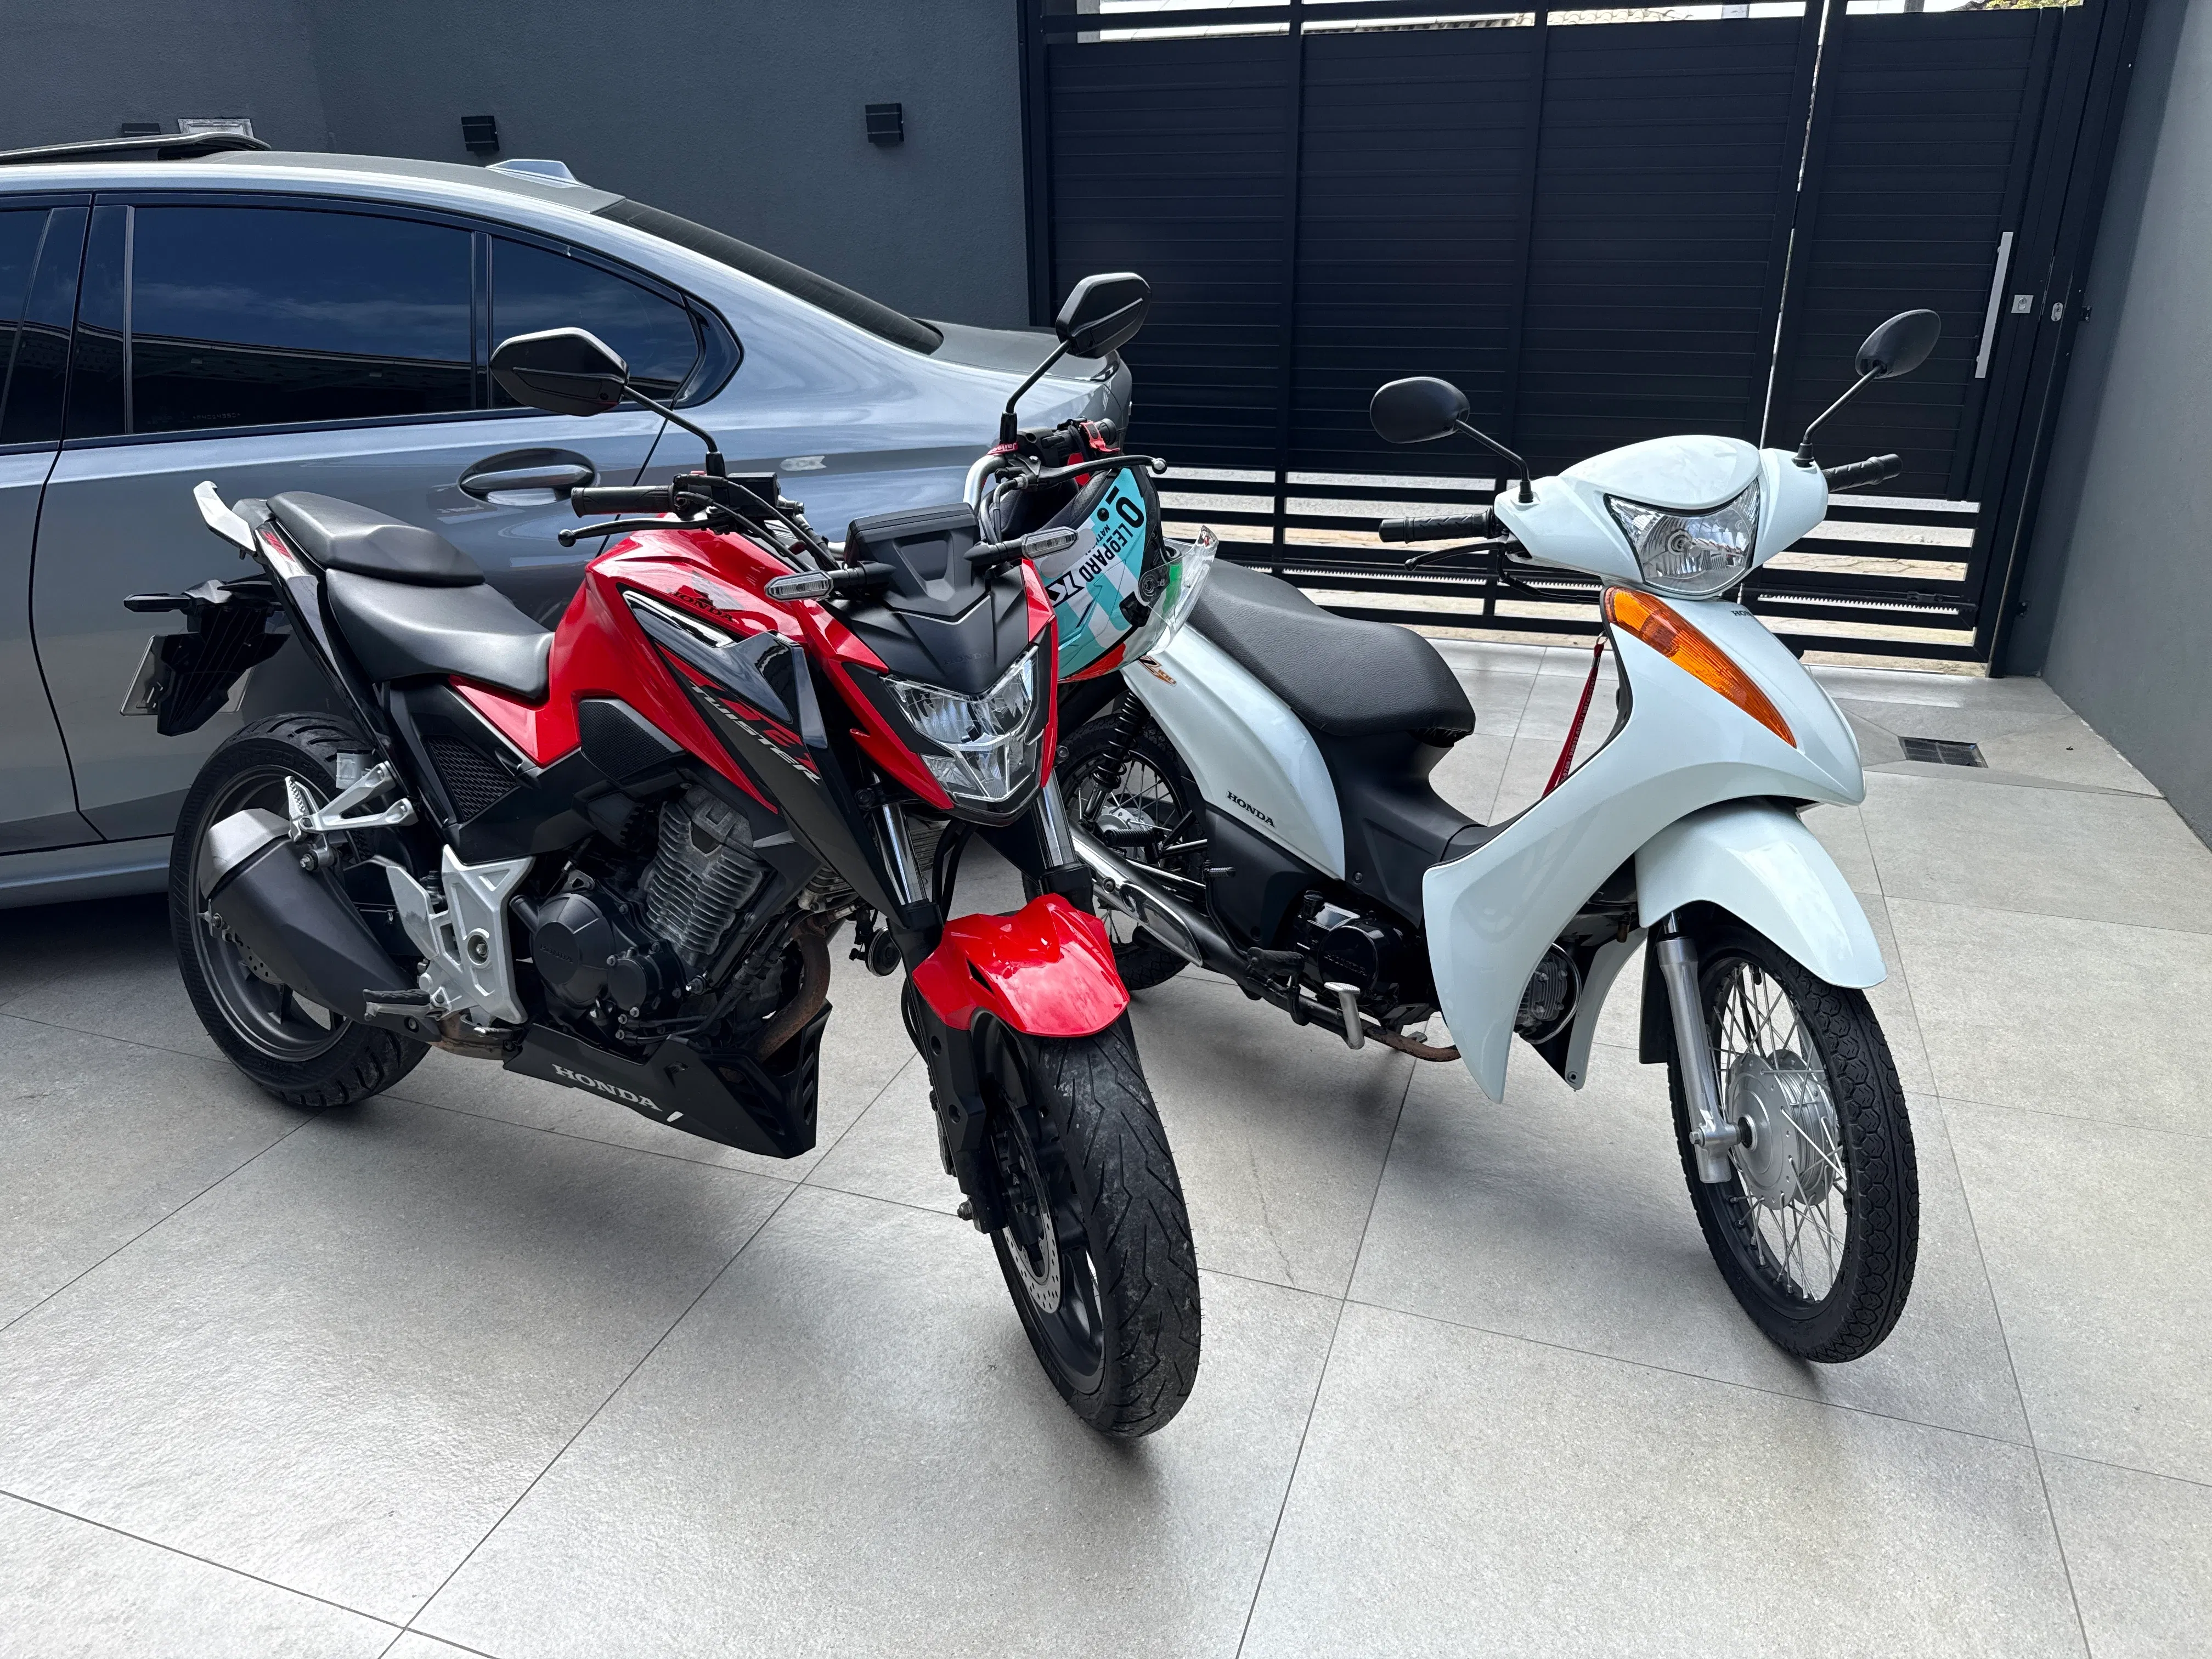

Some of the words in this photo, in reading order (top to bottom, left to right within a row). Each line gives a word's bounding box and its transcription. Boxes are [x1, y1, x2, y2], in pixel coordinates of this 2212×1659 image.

[689, 680, 821, 786] TWISTER
[1227, 791, 1276, 828] HONDA
[551, 1063, 663, 1112] HONDA
